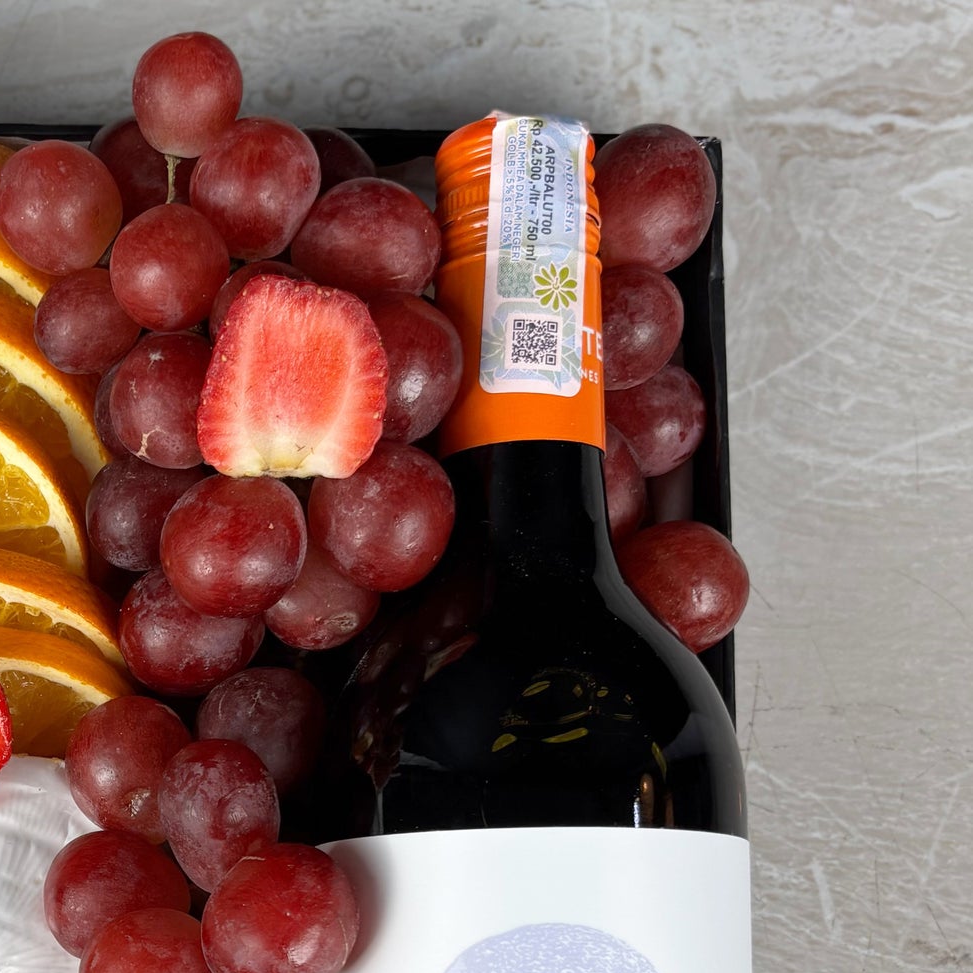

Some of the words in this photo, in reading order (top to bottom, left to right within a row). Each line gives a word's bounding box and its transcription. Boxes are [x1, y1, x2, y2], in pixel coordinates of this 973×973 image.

[517, 119, 528, 149] CUKAI
[530, 119, 544, 136] Rp
[516, 152, 527, 182] MMEA
[505, 178, 515, 194] 5%
[541, 145, 556, 235] ARPBALUT00
[564, 158, 575, 233] INDONESIA
[514, 184, 525, 221] DALAM
[502, 220, 512, 243] 20%
[512, 223, 523, 262] NEGERI
[527, 218, 539, 241] 750
[525, 244, 536, 261] ml
